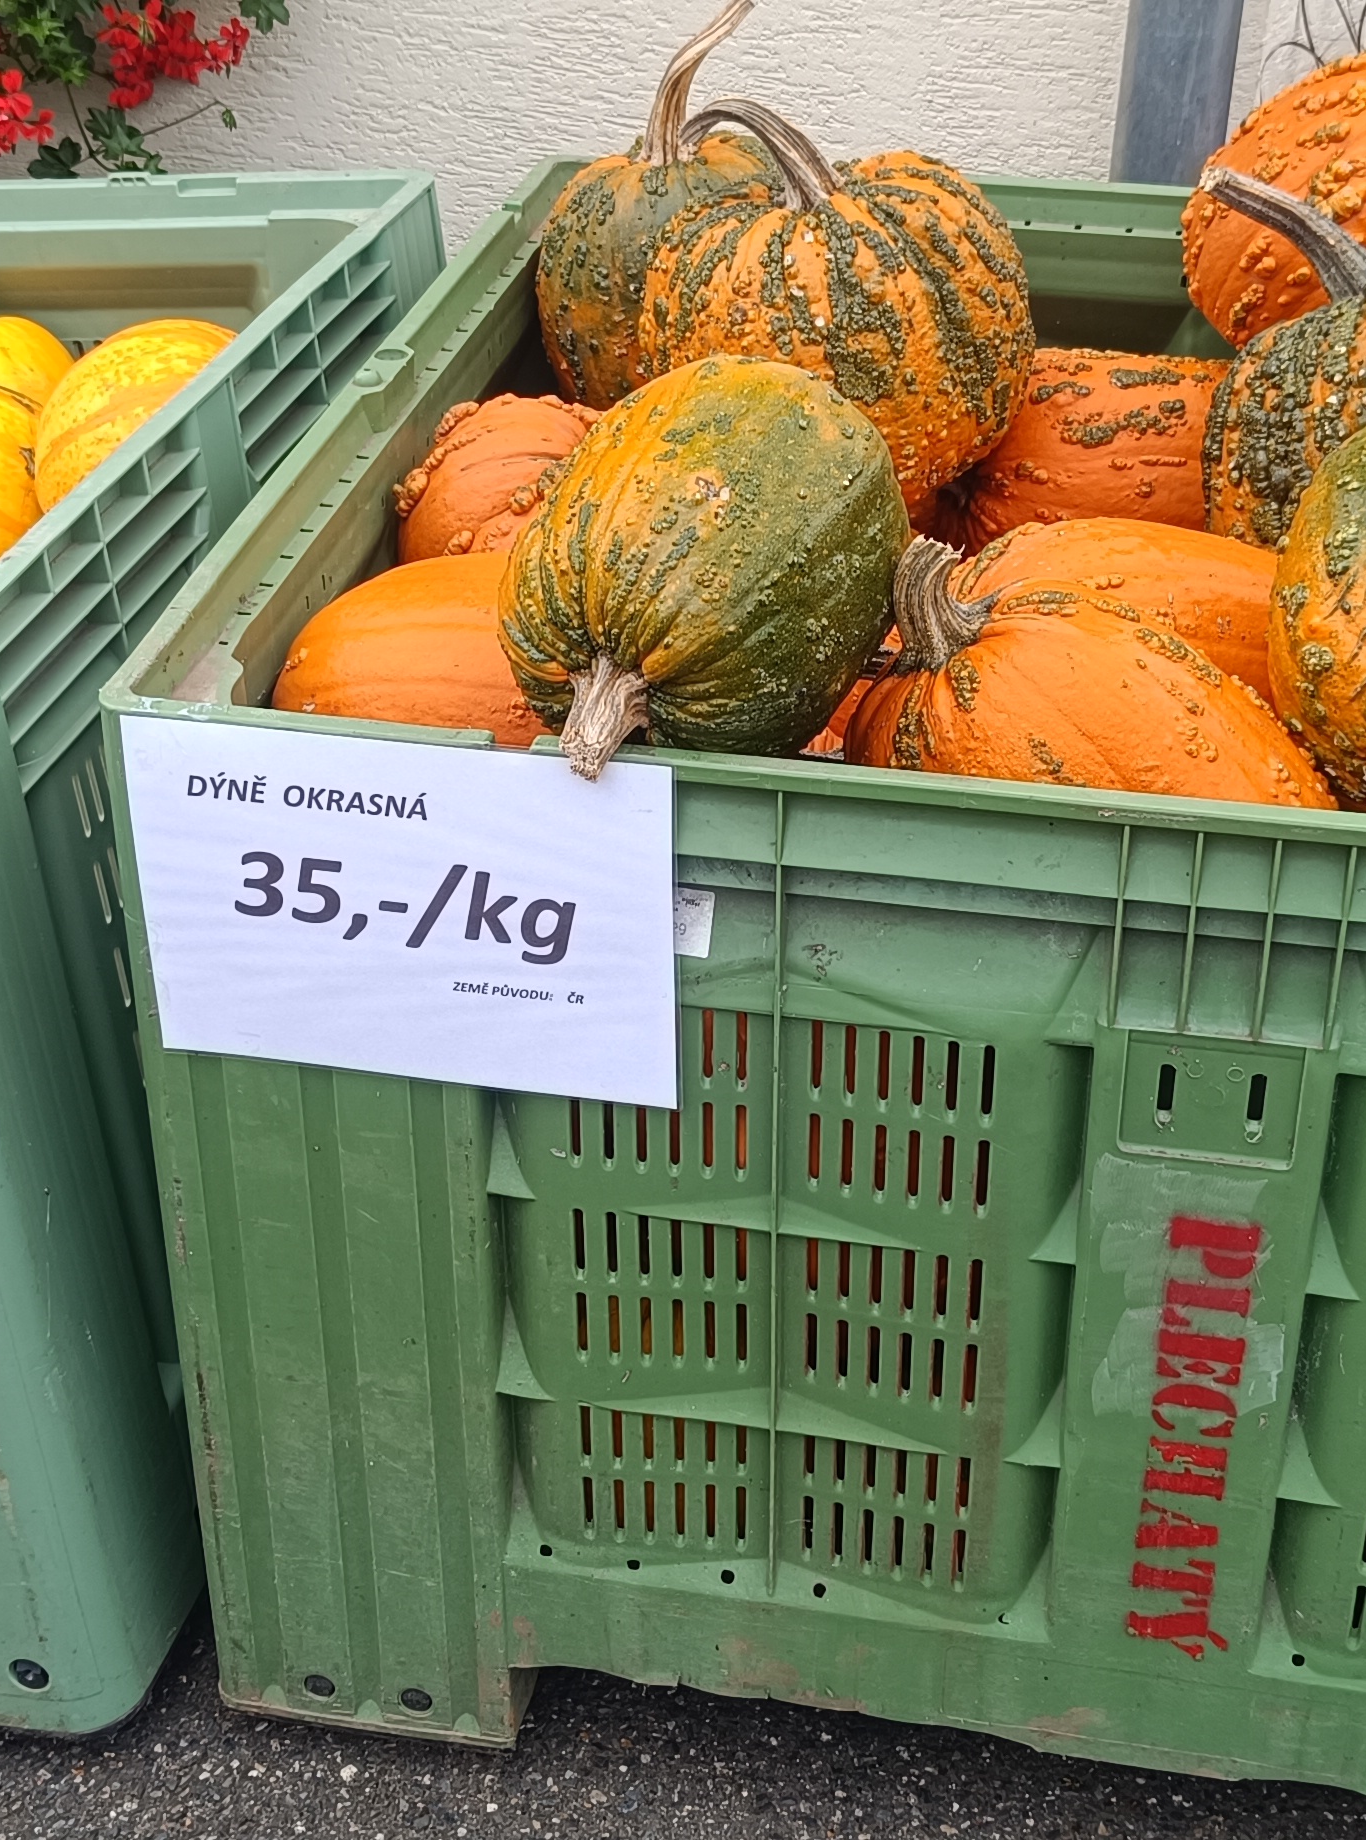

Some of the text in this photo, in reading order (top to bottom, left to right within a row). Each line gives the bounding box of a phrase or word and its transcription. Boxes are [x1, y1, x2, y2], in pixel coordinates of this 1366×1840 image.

[186, 772, 429, 821] DÝNĚ OKRASNÁ
[233, 850, 577, 966] 35,-/kg
[452, 981, 490, 995] ZEMĚ
[567, 991, 585, 1005] ČR
